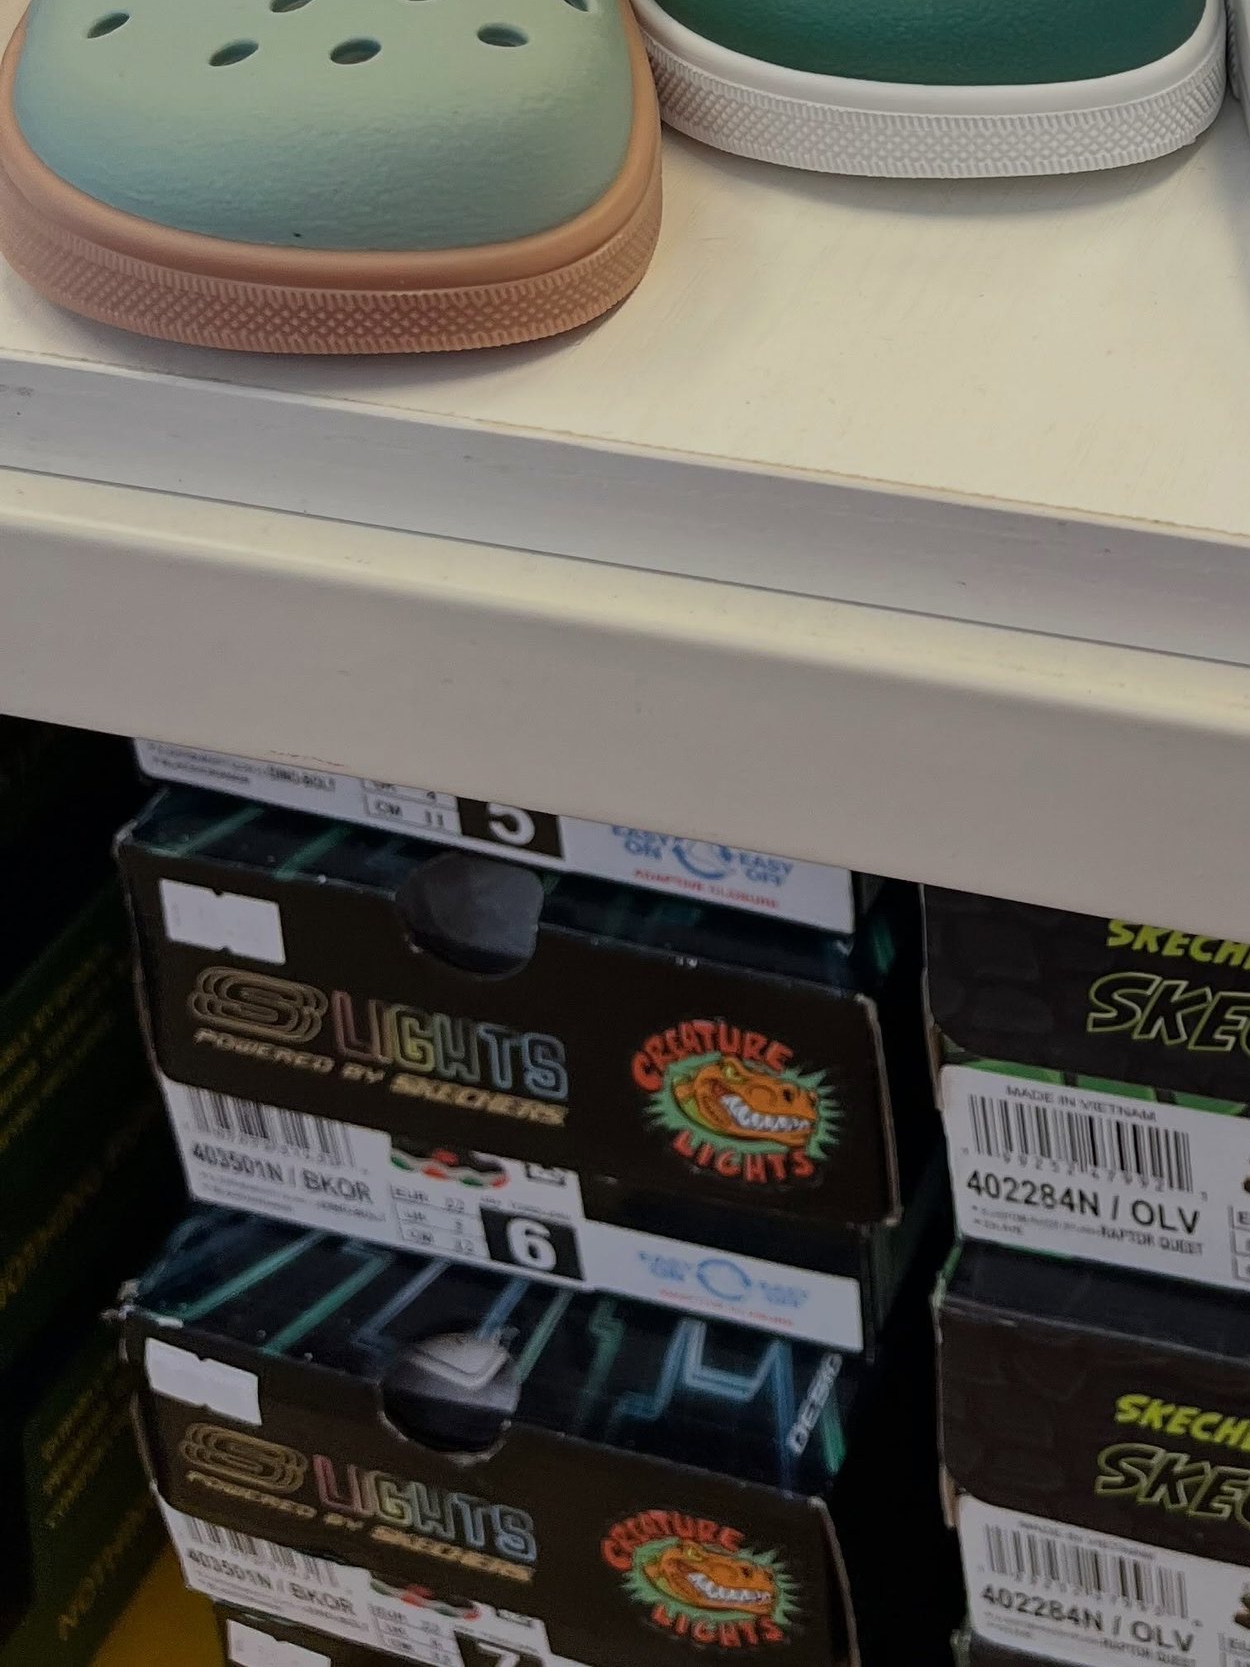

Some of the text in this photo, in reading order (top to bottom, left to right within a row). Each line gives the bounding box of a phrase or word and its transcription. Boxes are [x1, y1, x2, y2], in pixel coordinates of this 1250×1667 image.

[192, 1026, 570, 1127] POWERED BY SKECHERS
[331, 989, 570, 1102] LIGHTS
[630, 1018, 796, 1093] CREATURE
[1005, 1084, 1158, 1123] MADE IN VIETNAM
[671, 1129, 817, 1185] LIGHTS
[966, 1169, 1101, 1217] 402284N
[1110, 1195, 1121, 1220] /
[1131, 1199, 1201, 1234] OLV
[506, 1216, 557, 1273] 6
[1100, 1225, 1156, 1249] RAPTOR
[311, 1453, 539, 1564] LIGHTS
[599, 1508, 746, 1574] CREATURE
[650, 1603, 785, 1649] LIGHTS
[981, 1583, 1103, 1632] 402284N
[1130, 1620, 1195, 1653] OLV
